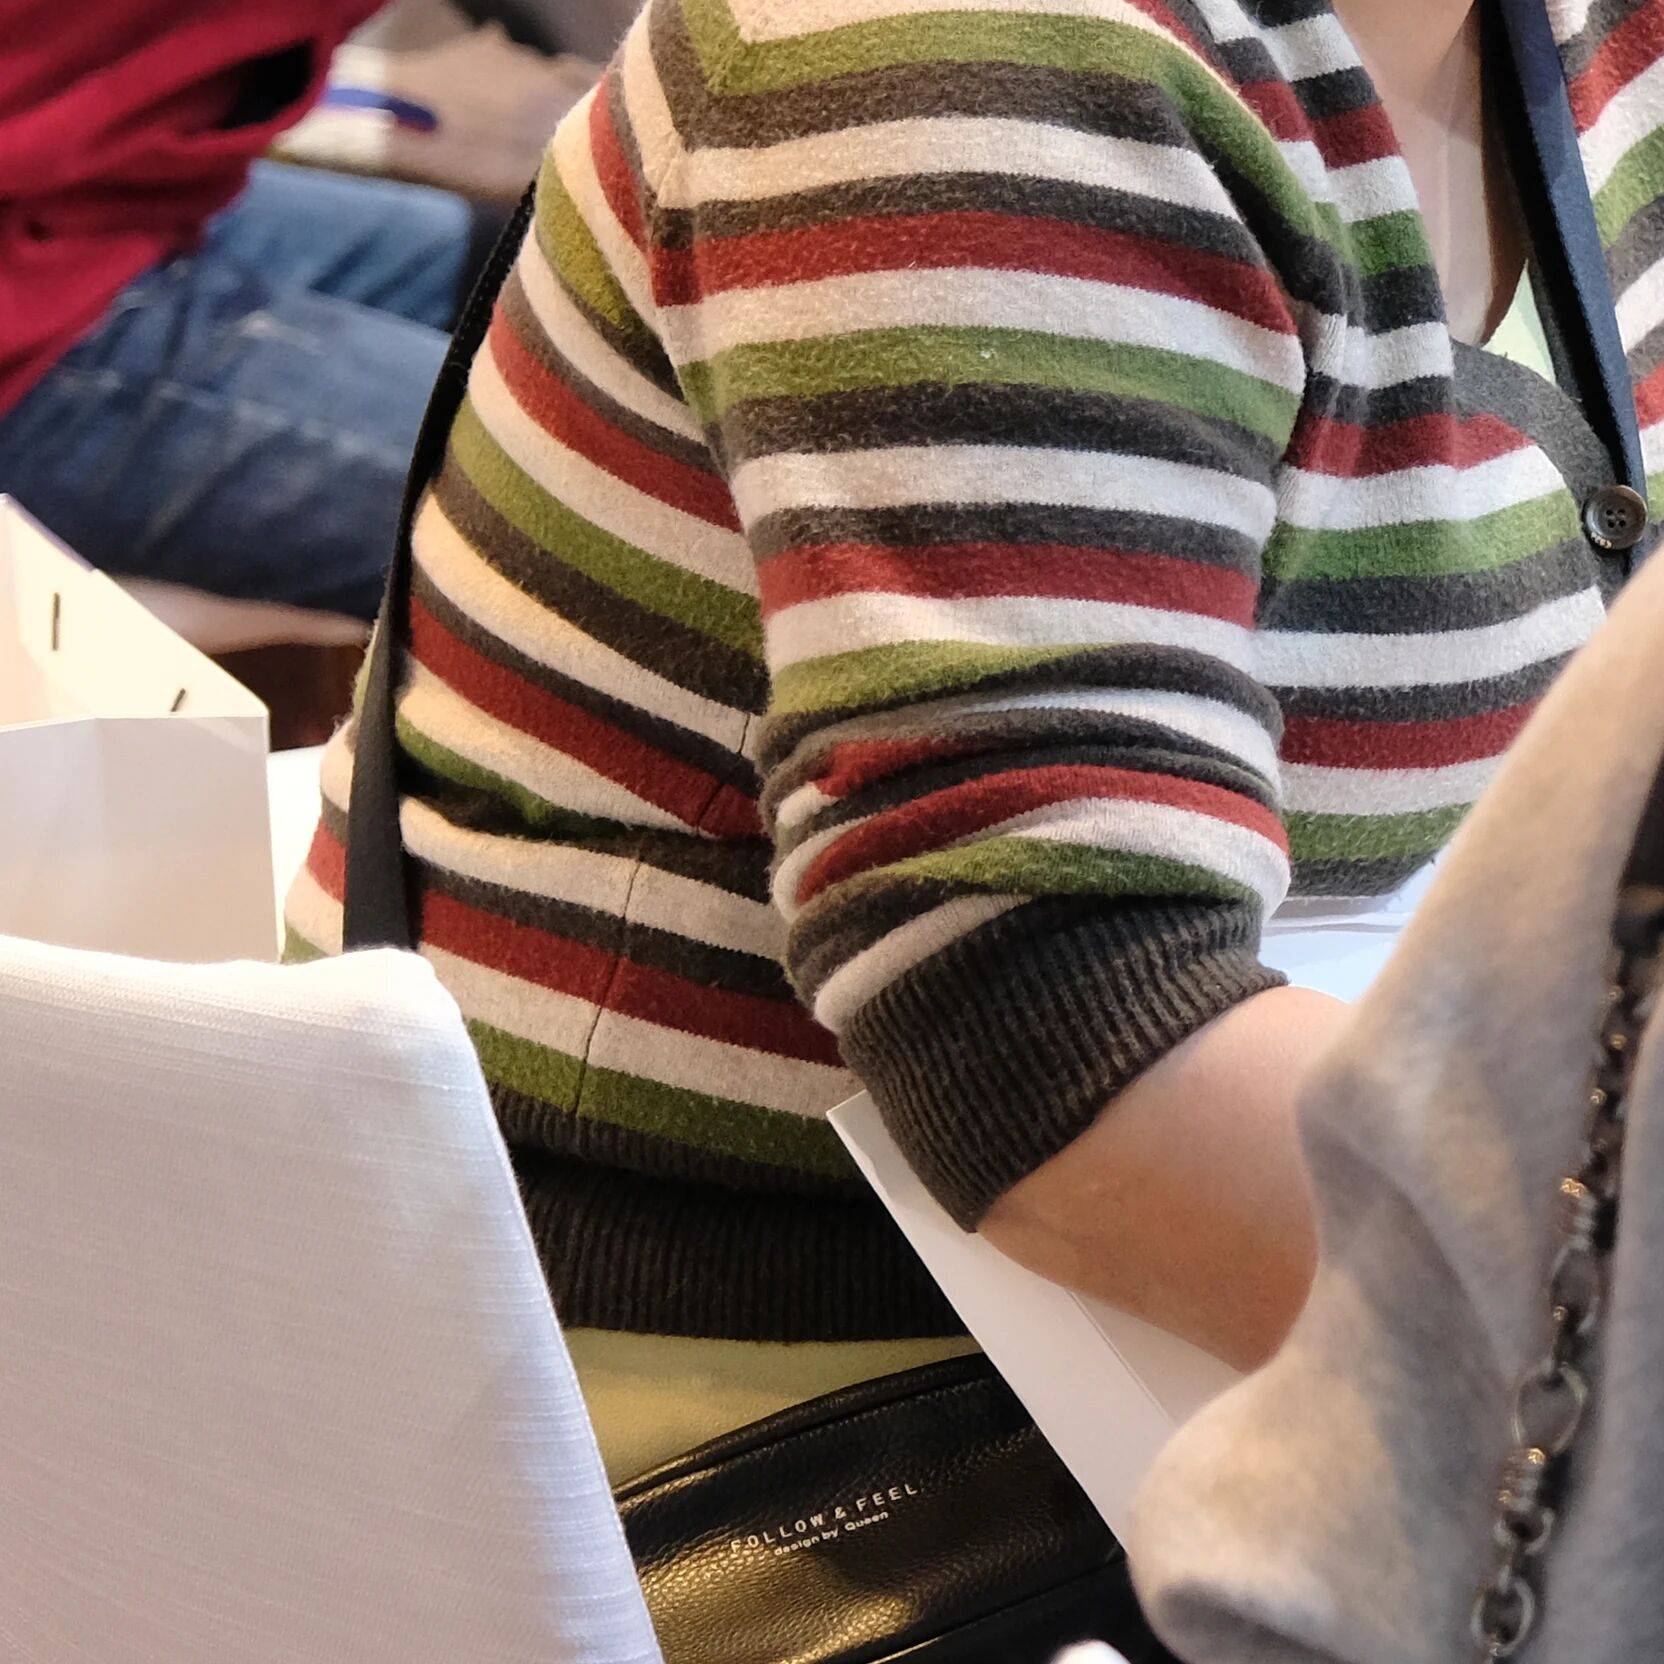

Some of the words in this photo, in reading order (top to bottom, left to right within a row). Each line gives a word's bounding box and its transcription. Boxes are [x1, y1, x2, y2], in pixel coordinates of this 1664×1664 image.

[731, 1513, 825, 1553] FOLLOW
[834, 1506, 847, 1519] &
[856, 1483, 918, 1512] FEEL
[774, 1535, 820, 1556] design
[821, 1528, 839, 1541] by
[845, 1511, 889, 1531] Queen
